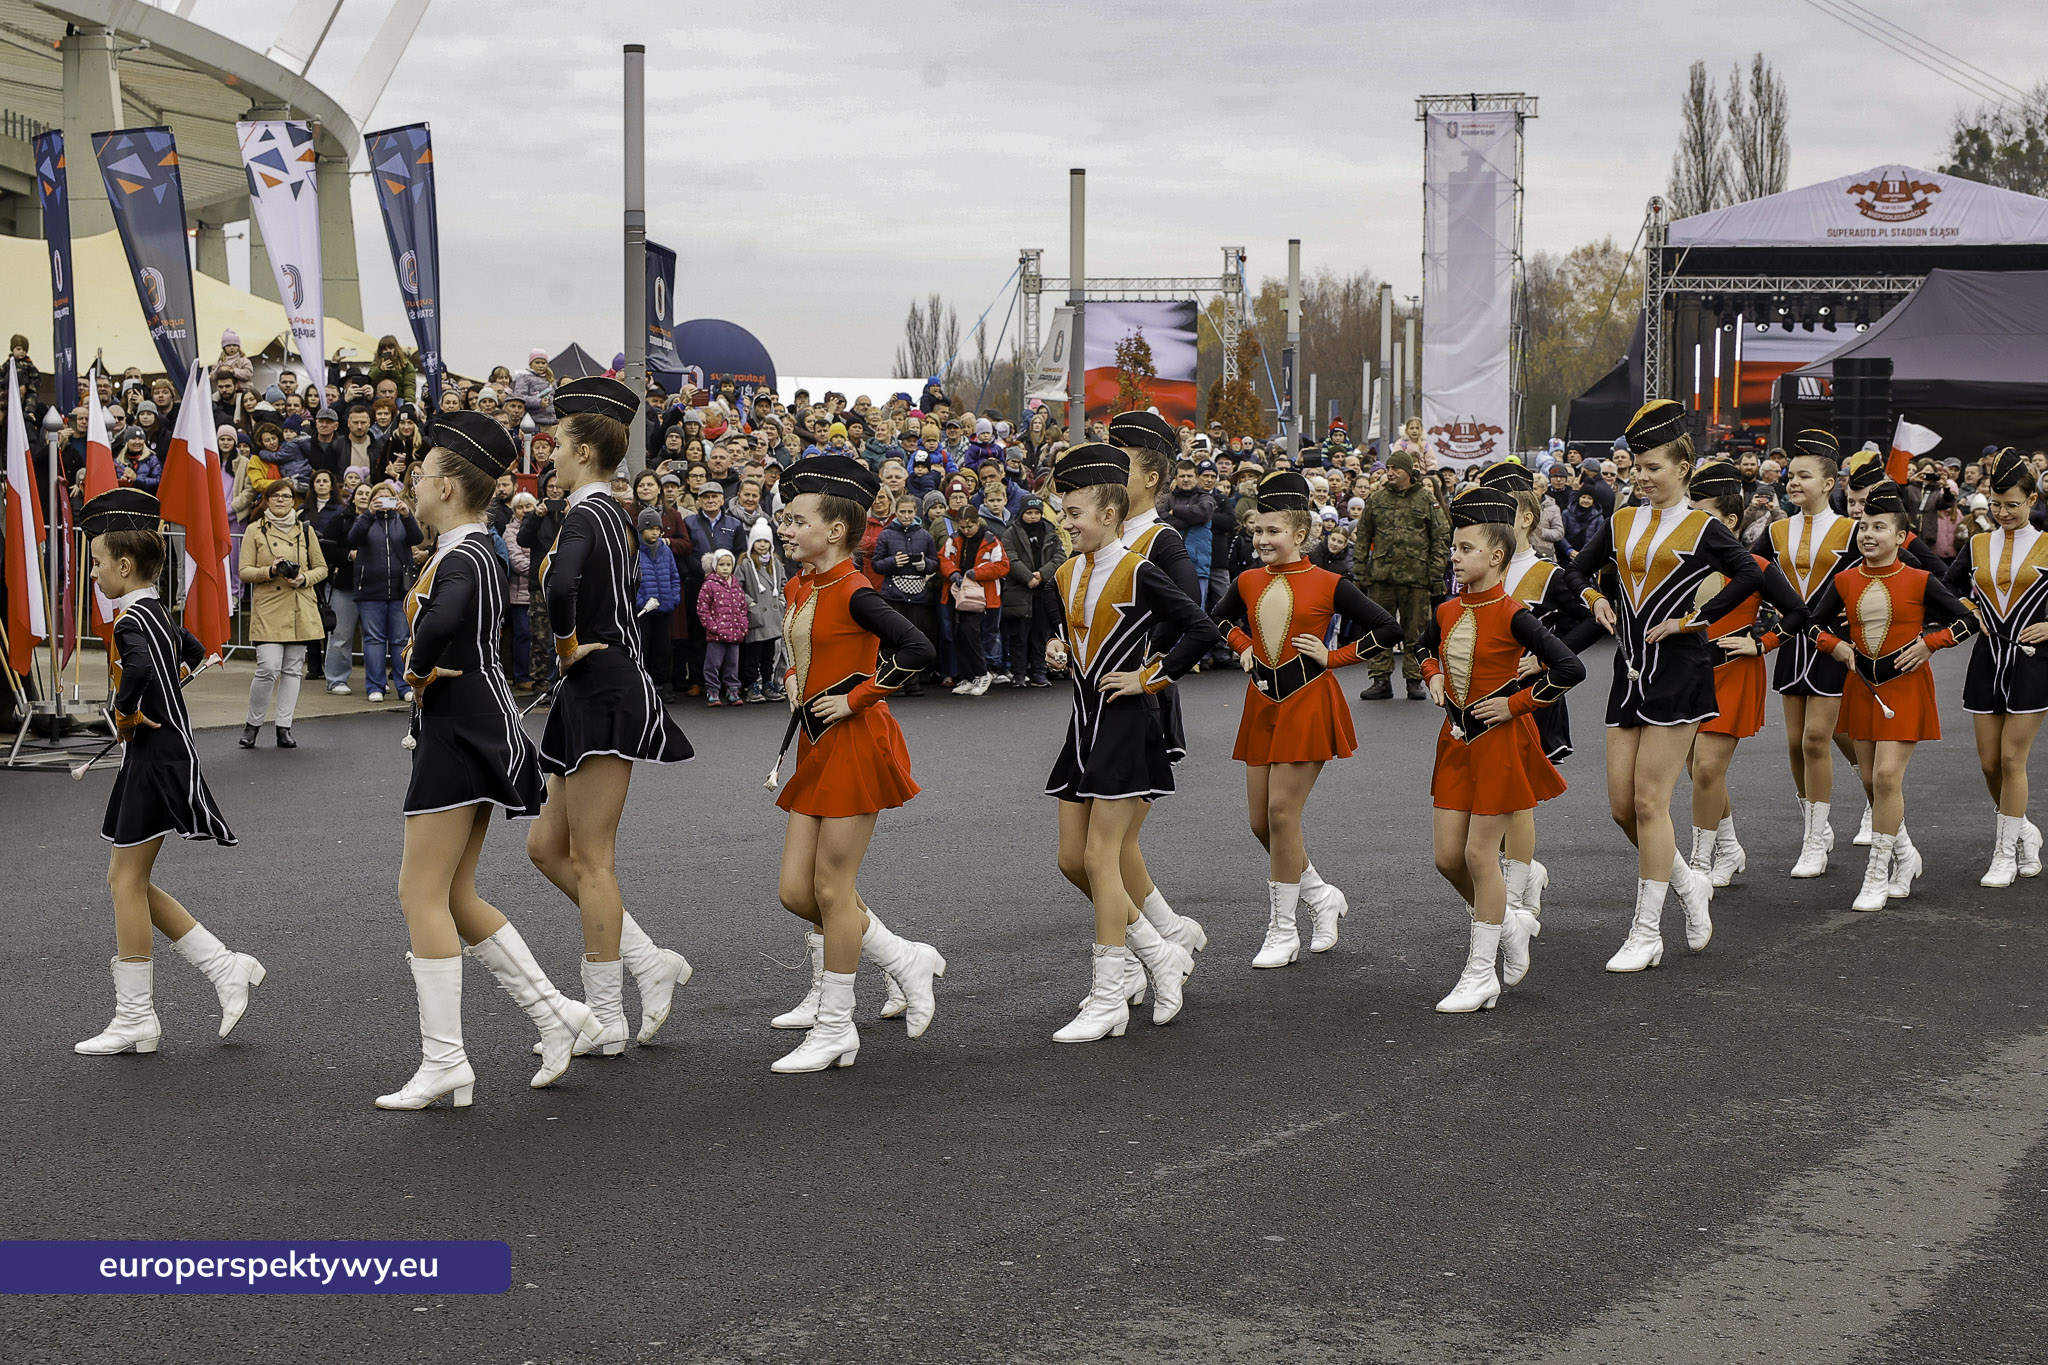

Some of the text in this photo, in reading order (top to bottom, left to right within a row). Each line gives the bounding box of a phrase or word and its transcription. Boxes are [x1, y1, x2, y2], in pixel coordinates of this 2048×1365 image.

[1888, 181, 1900, 193] 11
[1827, 228, 1888, 238] SUPERAUTO.PL
[1891, 228, 1927, 238] STADION
[1460, 423, 1470, 435] 11
